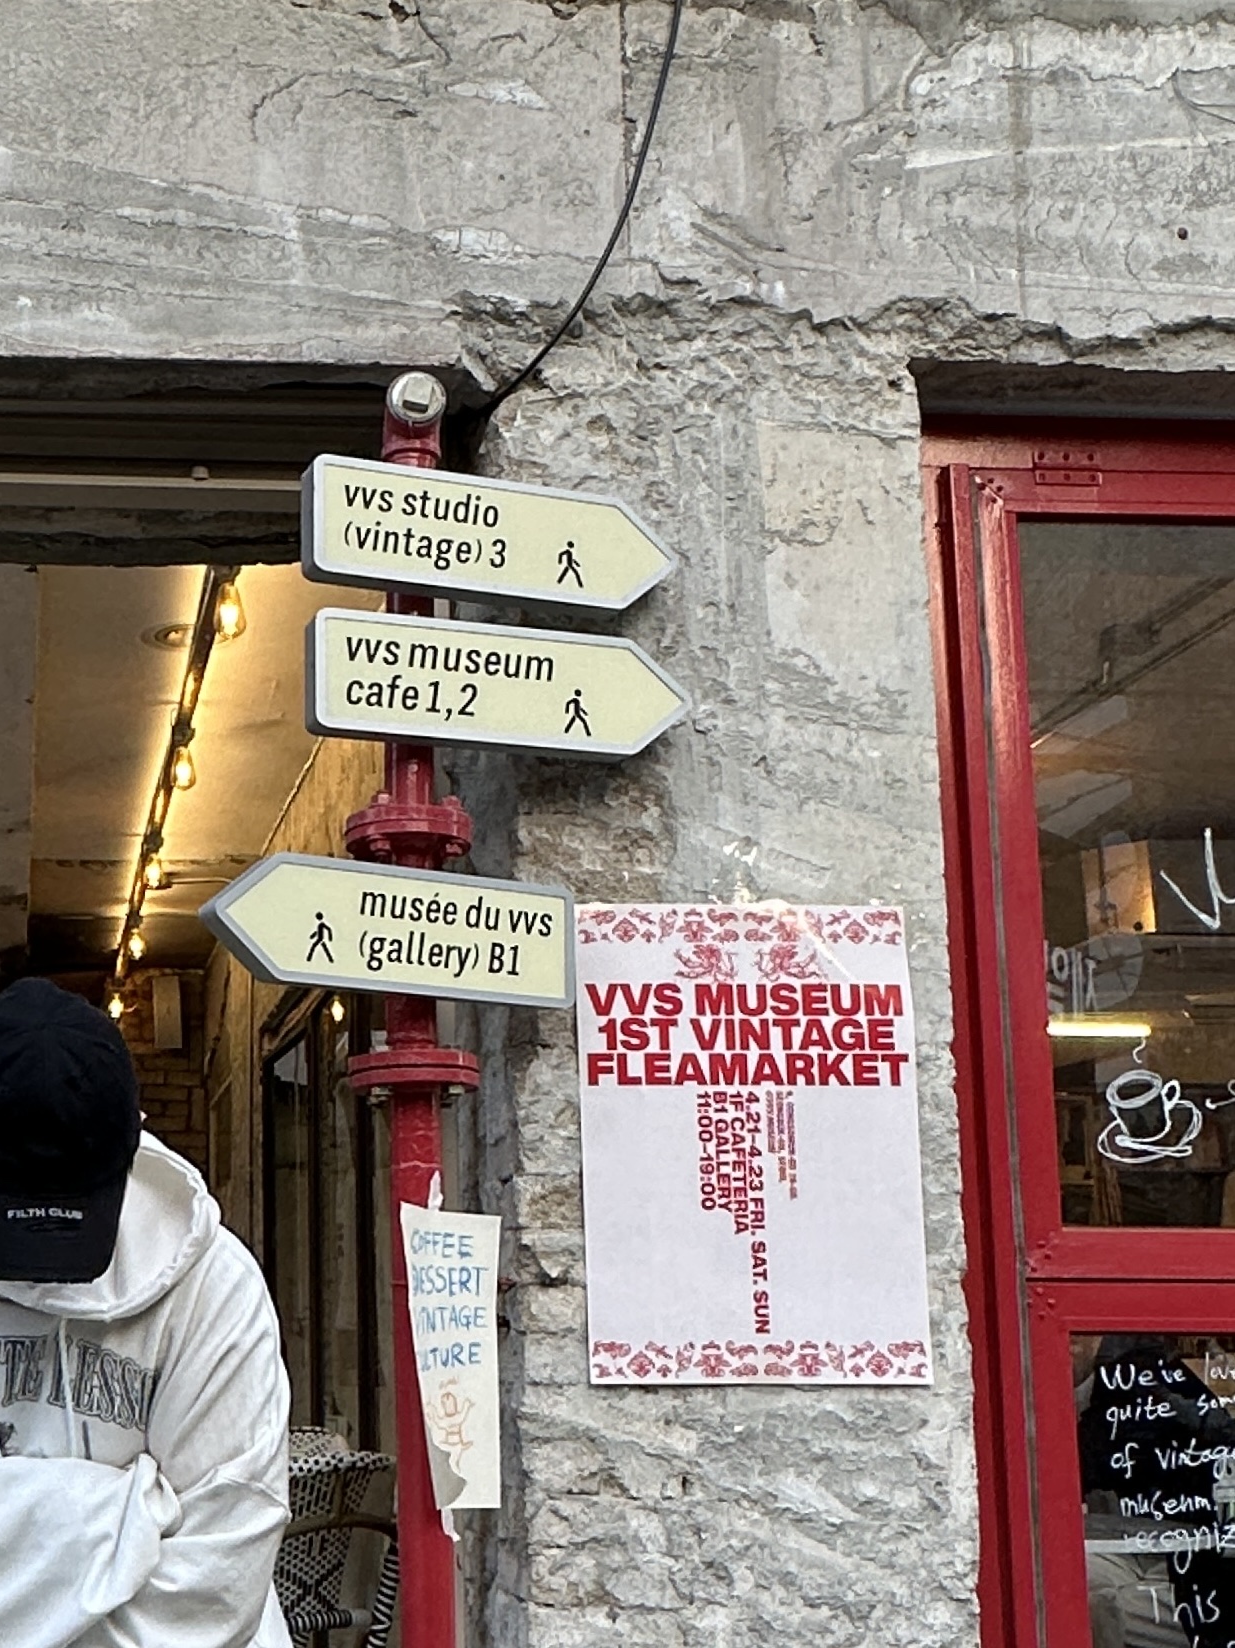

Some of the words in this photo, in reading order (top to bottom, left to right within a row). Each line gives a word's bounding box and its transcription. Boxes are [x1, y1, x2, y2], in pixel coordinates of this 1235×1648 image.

[344, 485, 394, 513] vvs
[401, 490, 499, 528] studio
[344, 521, 482, 570] (vintage)
[489, 538, 506, 568] 3
[346, 637, 401, 665] vvs
[408, 643, 554, 682] museum
[346, 675, 419, 710] cafe
[425, 681, 478, 721] 1,2
[360, 892, 458, 925] musée
[465, 896, 501, 931] du
[509, 909, 553, 937] vvs
[359, 930, 479, 978] (gallery)
[487, 942, 519, 976] B1
[585, 983, 682, 1016] VVS
[695, 983, 904, 1016] MUSEUM
[598, 1018, 679, 1050] 1ST
[690, 1018, 896, 1051] VINTAGE
[587, 1053, 909, 1086] FLEAMARKET
[712, 1091, 728, 1113] B1
[729, 1090, 745, 1113] 1F
[715, 1118, 732, 1213] GALLERY
[730, 1117, 749, 1235] CAFETERIA
[7, 1207, 46, 1219] FILTH
[48, 1207, 83, 1220] CLUB
[751, 1241, 768, 1285] SAT.
[753, 1290, 770, 1334] SUN
[1106, 1394, 1177, 1441] quite
[1110, 1442, 1140, 1479] of
[1136, 1583, 1220, 1628] This
